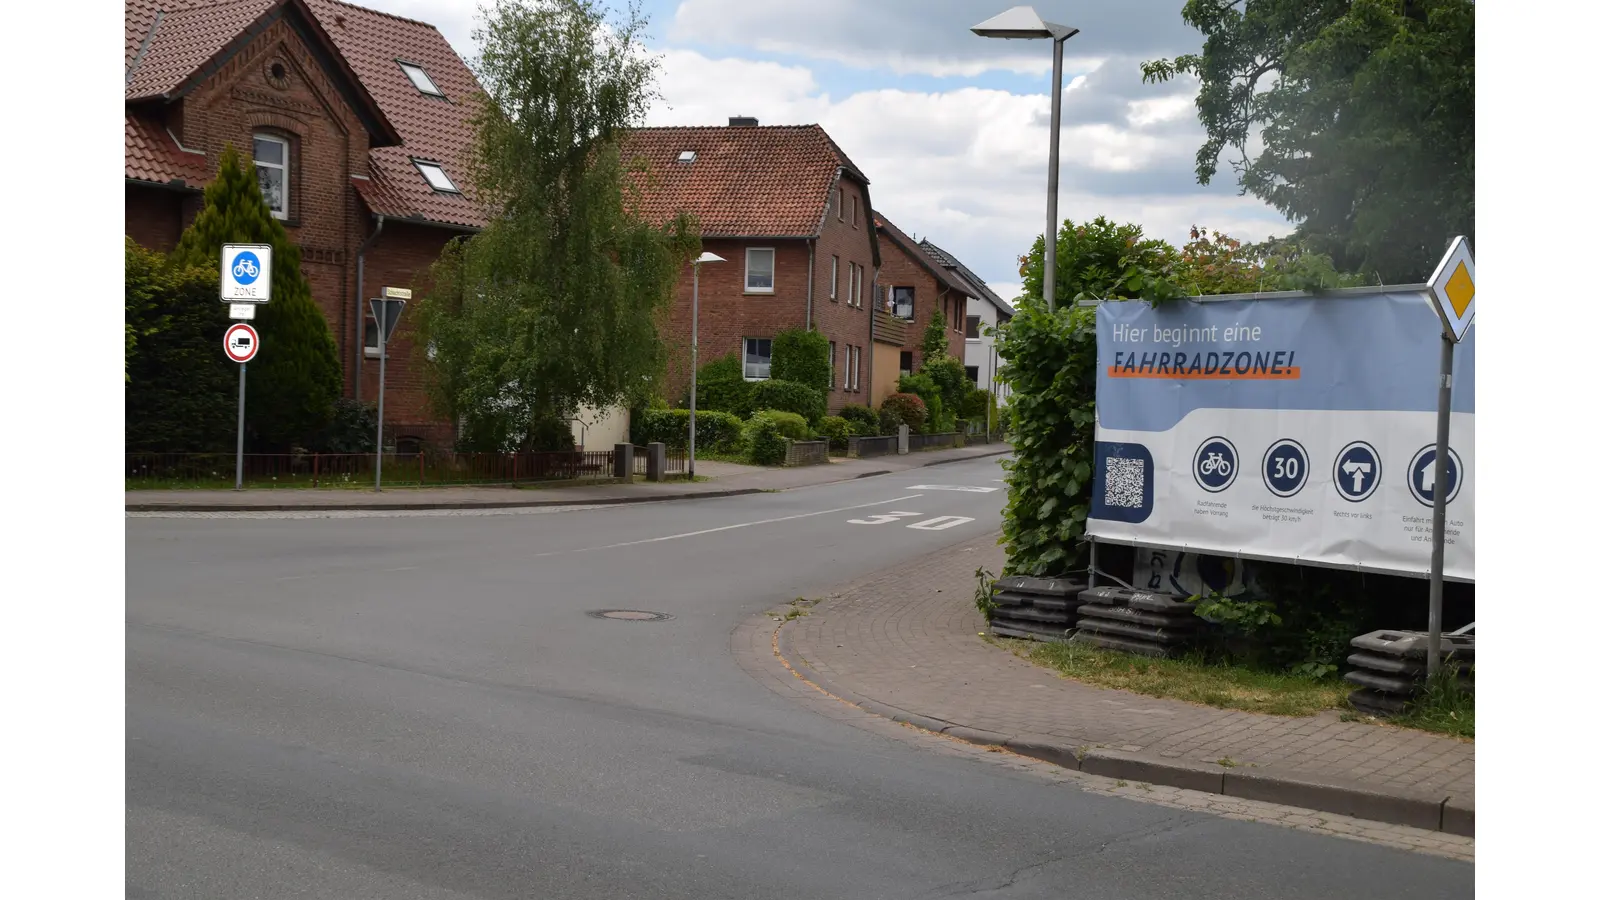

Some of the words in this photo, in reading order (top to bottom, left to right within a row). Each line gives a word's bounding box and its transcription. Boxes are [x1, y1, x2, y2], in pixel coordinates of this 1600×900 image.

[234, 286, 256, 296] ZONE
[1113, 324, 1148, 342] Hier
[1153, 324, 1218, 348] beginnt
[1223, 322, 1261, 341] eine
[1114, 351, 1295, 375] FAHRRADZONE!
[1274, 457, 1298, 479] 30
[1197, 500, 1227, 509] Radfahrende
[1210, 510, 1228, 518] Vorrang
[1260, 505, 1313, 515] Höchstgeschwindigkeit
[1334, 510, 1349, 518] Rechts
[846, 511, 976, 531] 30
[1263, 514, 1280, 522] beträgt
[1402, 515, 1424, 523] Einfahrt
